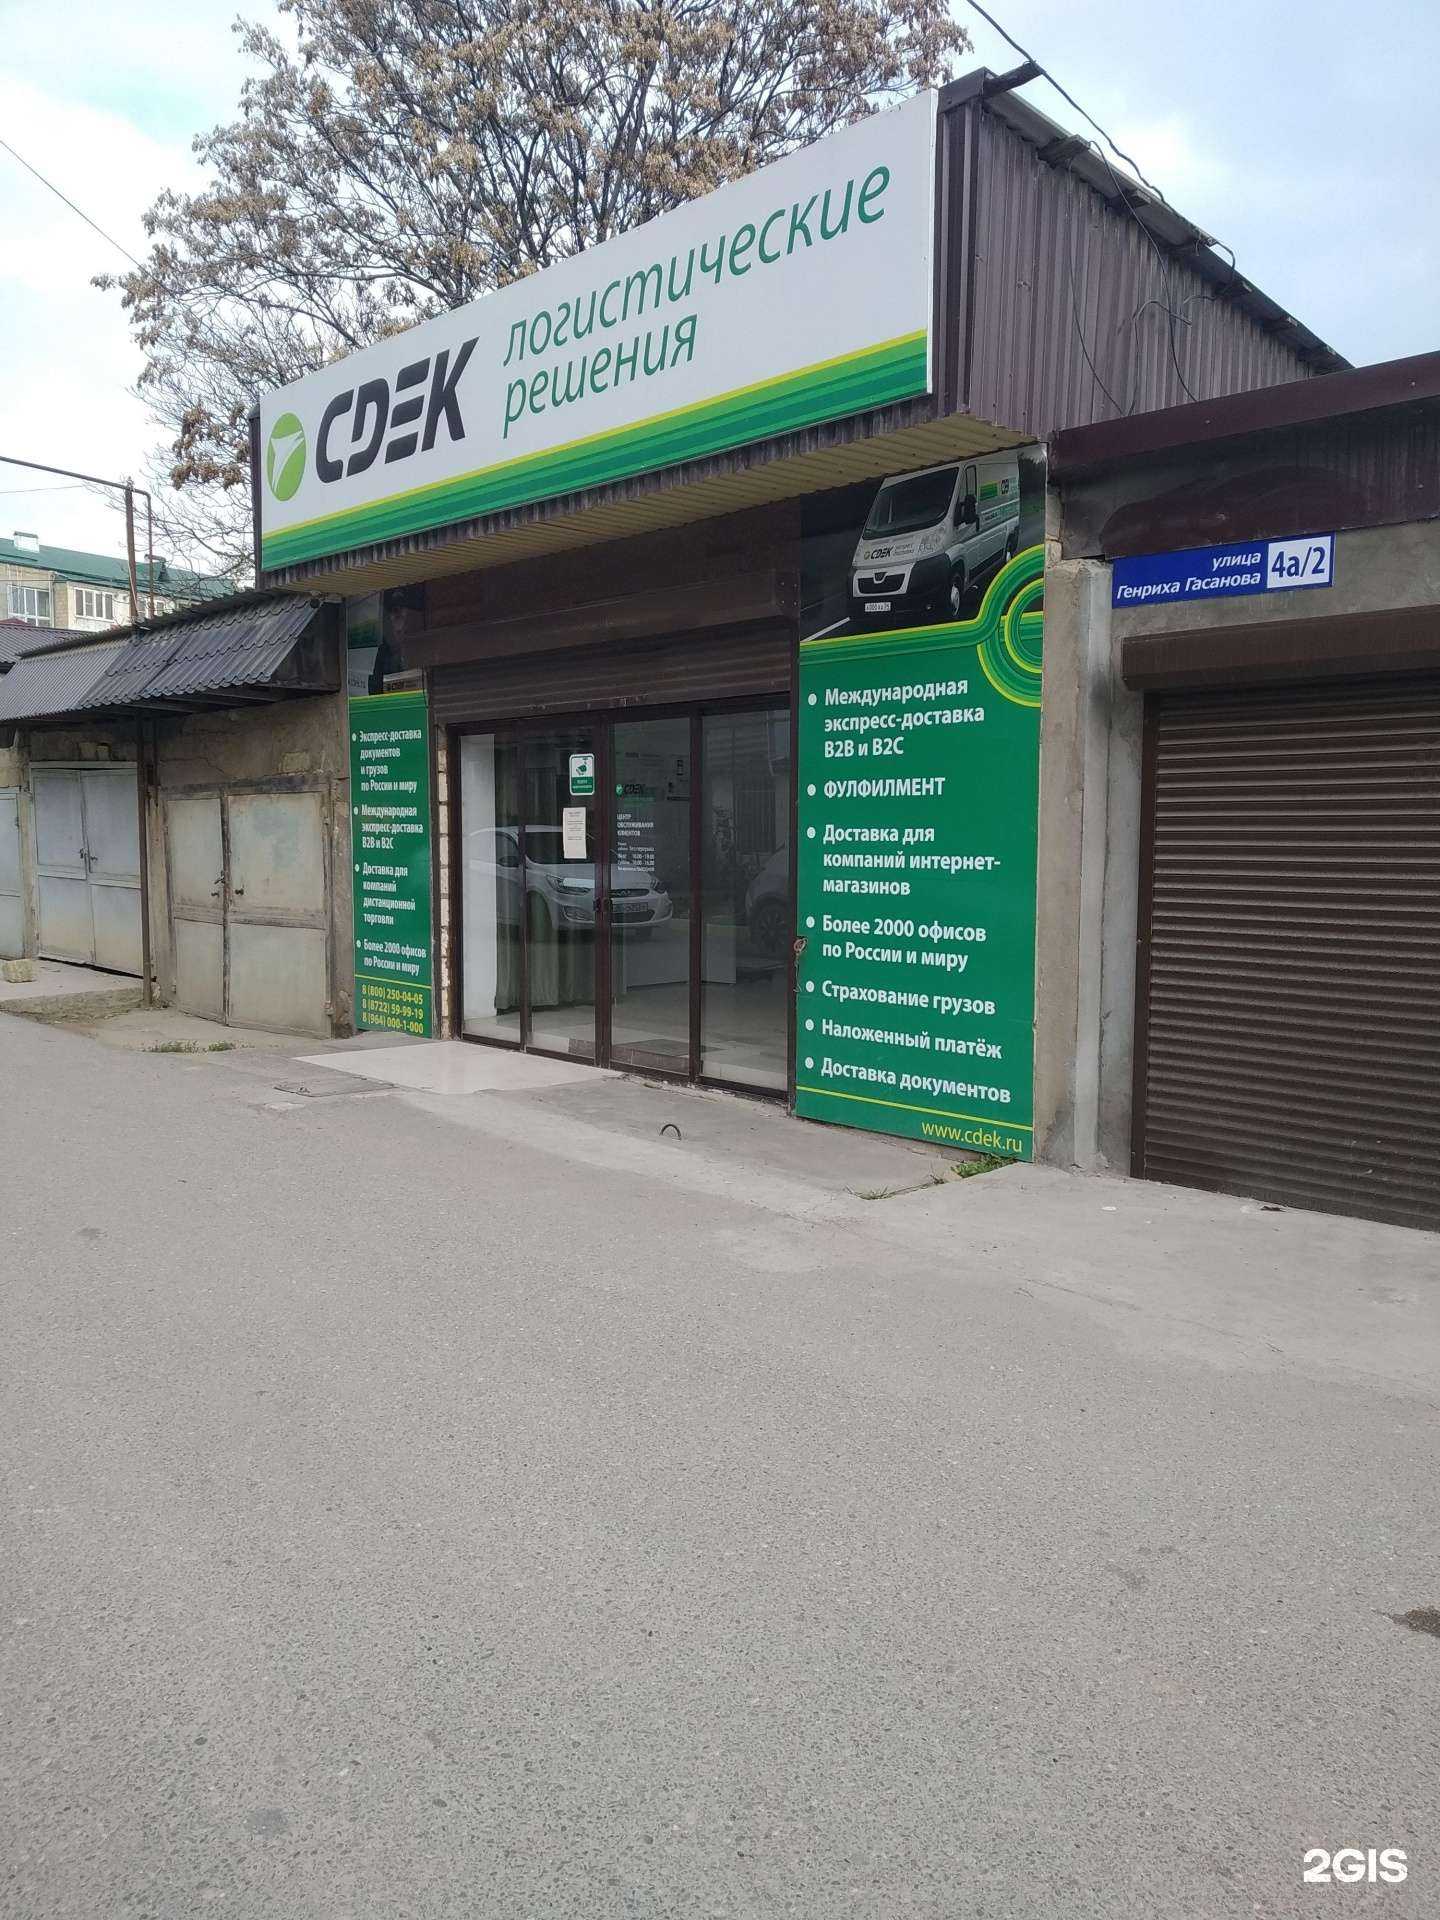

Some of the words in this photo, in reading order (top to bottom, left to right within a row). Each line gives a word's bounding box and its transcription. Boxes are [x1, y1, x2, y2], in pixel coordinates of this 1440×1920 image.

[503, 165, 891, 367] логистические
[503, 314, 699, 438] решения
[315, 337, 479, 485] CDEK
[1212, 551, 1261, 571] улица
[1271, 546, 1326, 578] 4а/2
[1117, 581, 1180, 600] Генриха
[1185, 572, 1260, 592] Гасанова
[825, 678, 968, 707] Международная
[824, 706, 985, 734] экспресс-доставка
[360, 730, 421, 744] Экспресс-доставка
[360, 747, 400, 761] документов
[858, 744, 868, 756] и
[366, 765, 388, 777] грузов
[361, 781, 369, 791] по
[370, 780, 392, 791] России
[399, 781, 417, 793] миру
[824, 777, 945, 798] ФУЛФИЛМЕНТ
[361, 804, 417, 819] Международная
[361, 822, 423, 834] экспресс-доставка
[823, 824, 899, 844] Доставка
[903, 827, 935, 846] для
[363, 862, 393, 876] Доставка
[394, 867, 408, 877] для
[823, 851, 905, 869] компаний
[909, 855, 1001, 876] интернет-
[363, 880, 396, 892] компаний
[823, 878, 910, 896] магазинов
[363, 897, 416, 911] дистанционной
[363, 913, 394, 926] торговли
[823, 915, 870, 935] Более
[874, 918, 914, 938] 2000
[918, 922, 986, 943] офисов
[364, 939, 384, 952] Более
[384, 942, 400, 954] 2000
[401, 944, 426, 958] офисов
[823, 944, 841, 958] по
[846, 942, 902, 964] России
[906, 950, 917, 964] и
[921, 952, 968, 973] миру
[363, 957, 373, 966] по
[373, 956, 395, 970] России
[402, 963, 420, 976] миру
[362, 984, 367, 994] 8
[367, 985, 386, 999] (800)
[386, 989, 423, 1005] 250-04-05
[822, 980, 929, 1008] Страхование
[933, 995, 995, 1015] грузов
[362, 998, 367, 1009] 8
[367, 999, 390, 1014] (8722)
[391, 1004, 423, 1019] 59-99-19
[362, 1012, 367, 1022] 8
[368, 1012, 386, 1027] (964)
[386, 1017, 423, 1034] 000-1-000
[822, 1018, 930, 1049] Наложенный
[935, 1037, 1002, 1059] платёж
[821, 1058, 896, 1085] Доставка
[900, 1073, 1011, 1104] документов
[921, 1120, 1023, 1153] www.cdek.ru
